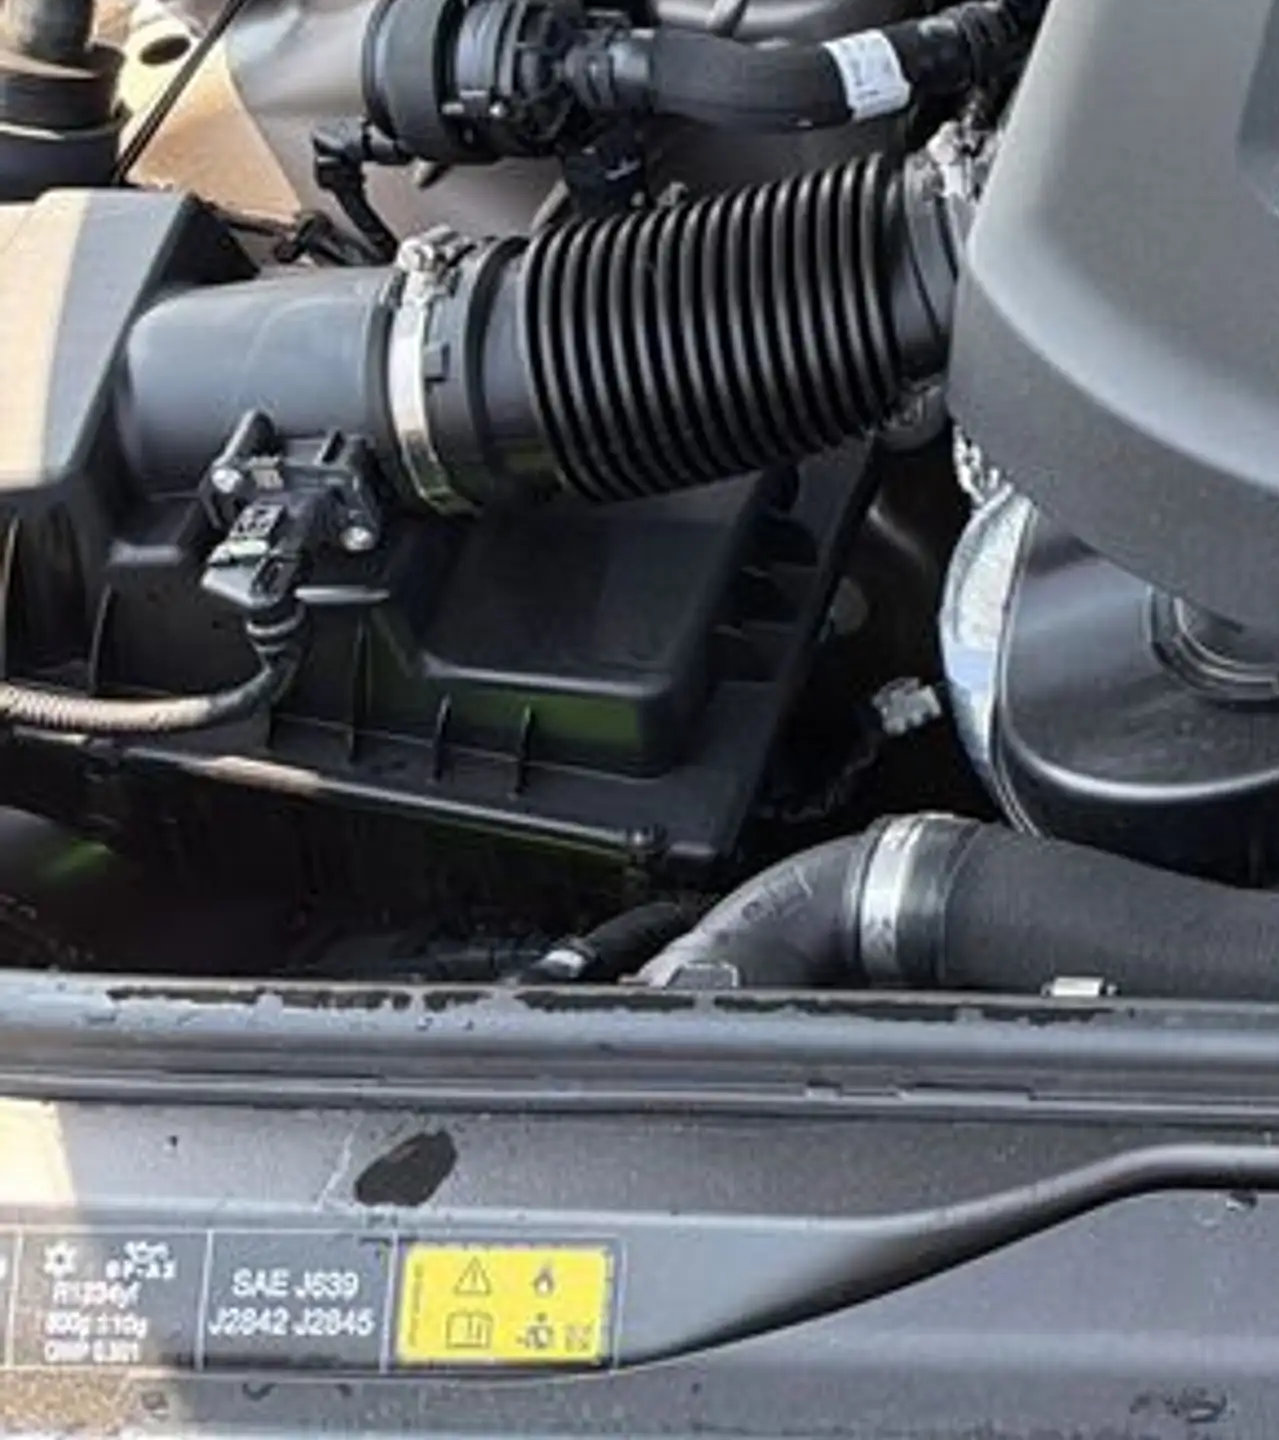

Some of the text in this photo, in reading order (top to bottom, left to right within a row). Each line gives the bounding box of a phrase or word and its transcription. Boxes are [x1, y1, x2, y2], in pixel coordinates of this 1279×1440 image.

[231, 1271, 359, 1300] SAE J639
[208, 1306, 375, 1337] J2842 J2845
